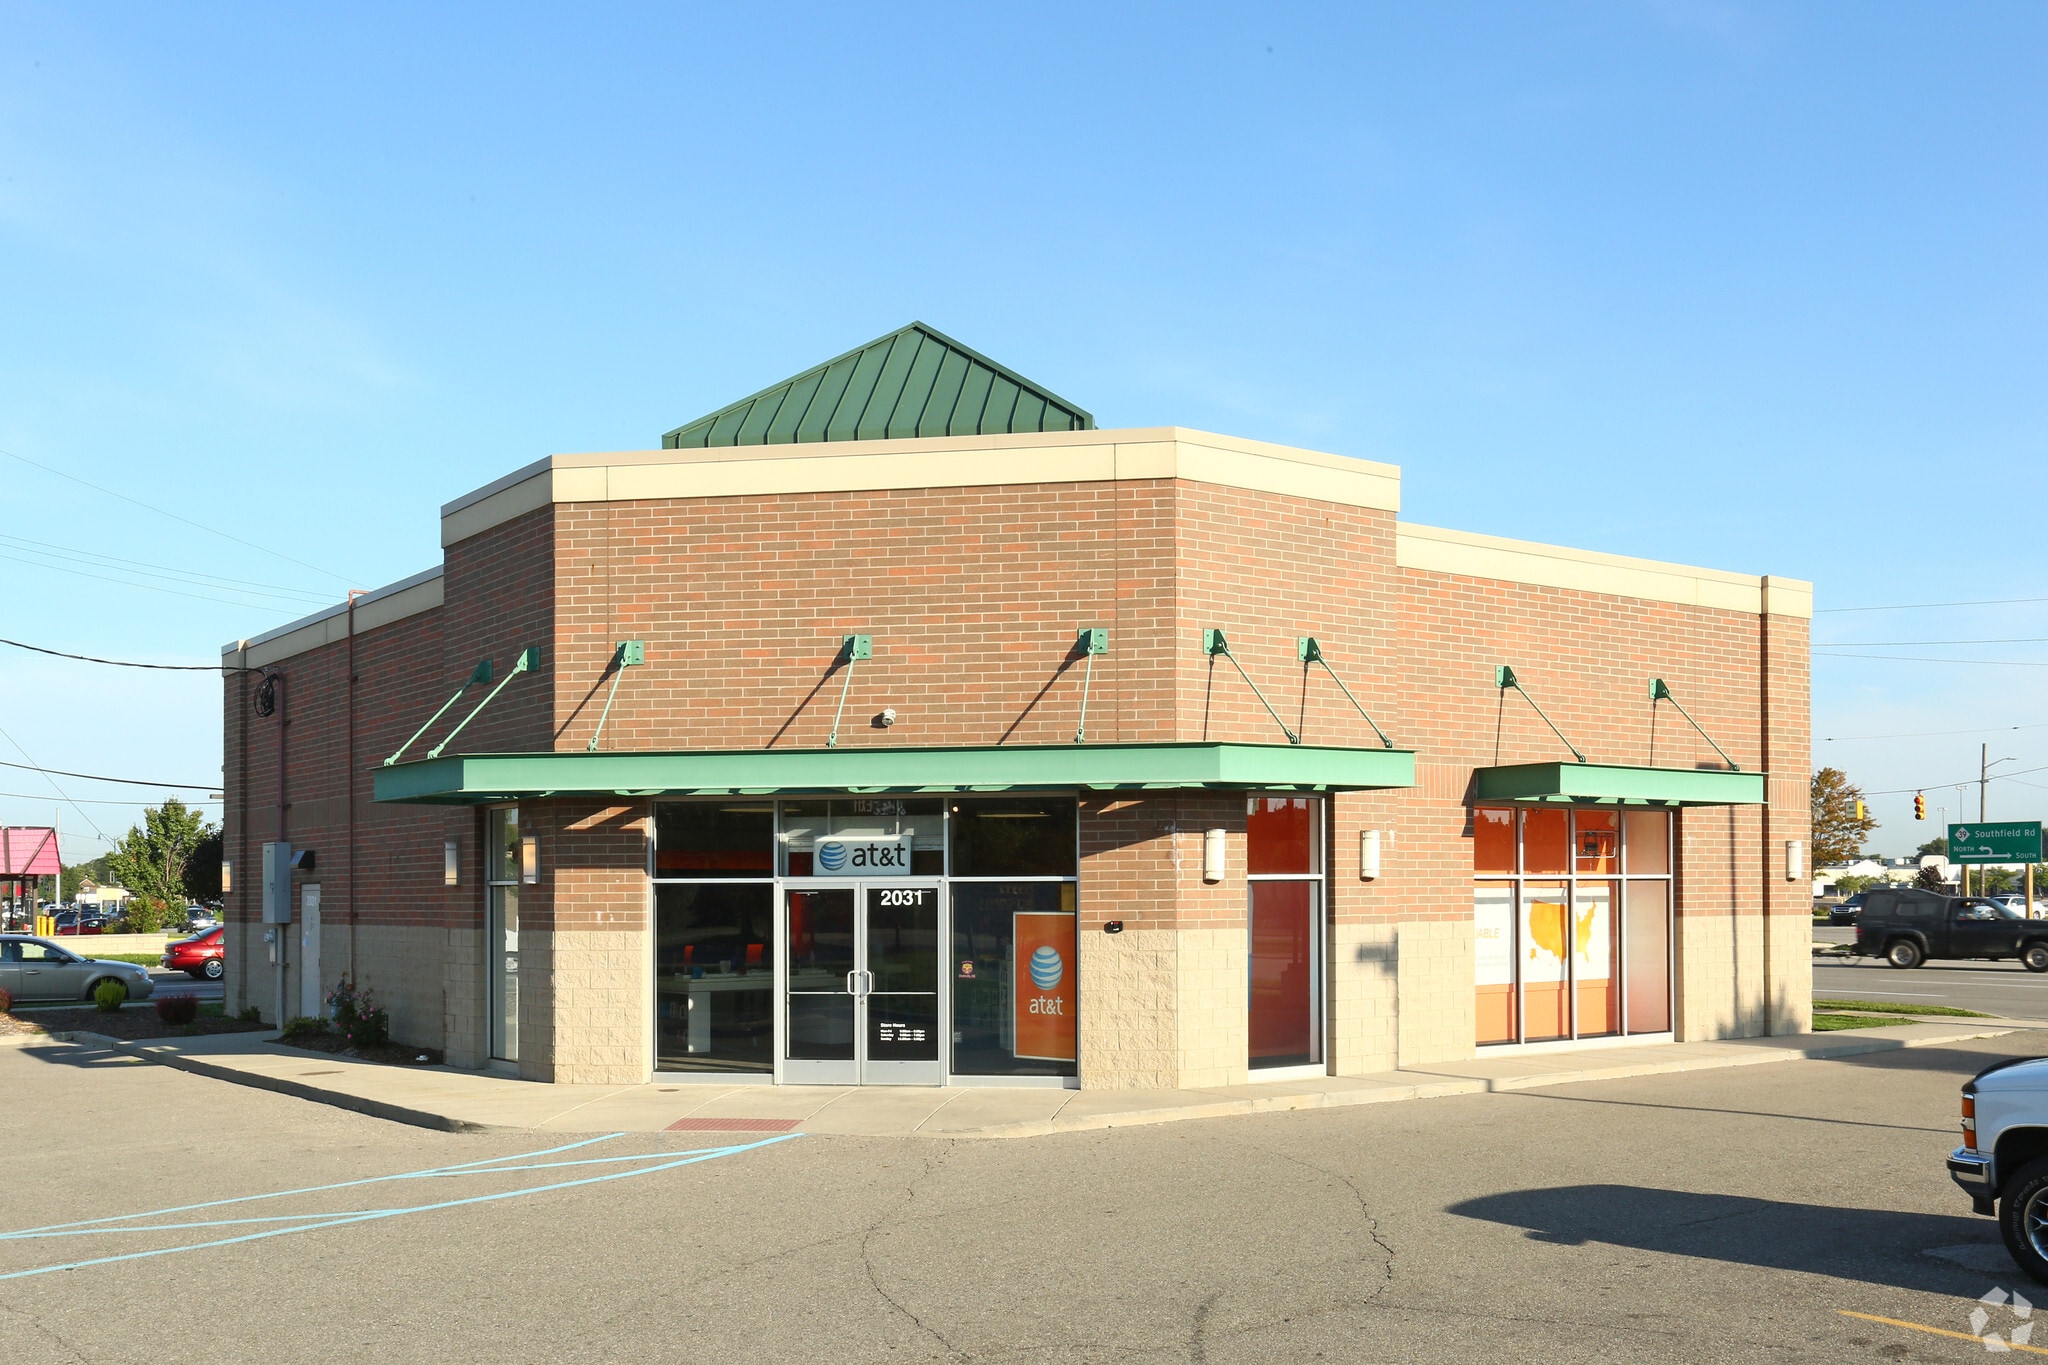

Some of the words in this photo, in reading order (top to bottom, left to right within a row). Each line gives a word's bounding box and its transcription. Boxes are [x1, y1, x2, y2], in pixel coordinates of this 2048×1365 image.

[1958, 830, 1967, 839] 39
[1975, 829, 2021, 838] Southfield
[2024, 828, 2036, 837] Rd
[852, 842, 906, 867] at&t
[880, 889, 922, 906] 2031
[1029, 995, 1064, 1016] at&t
